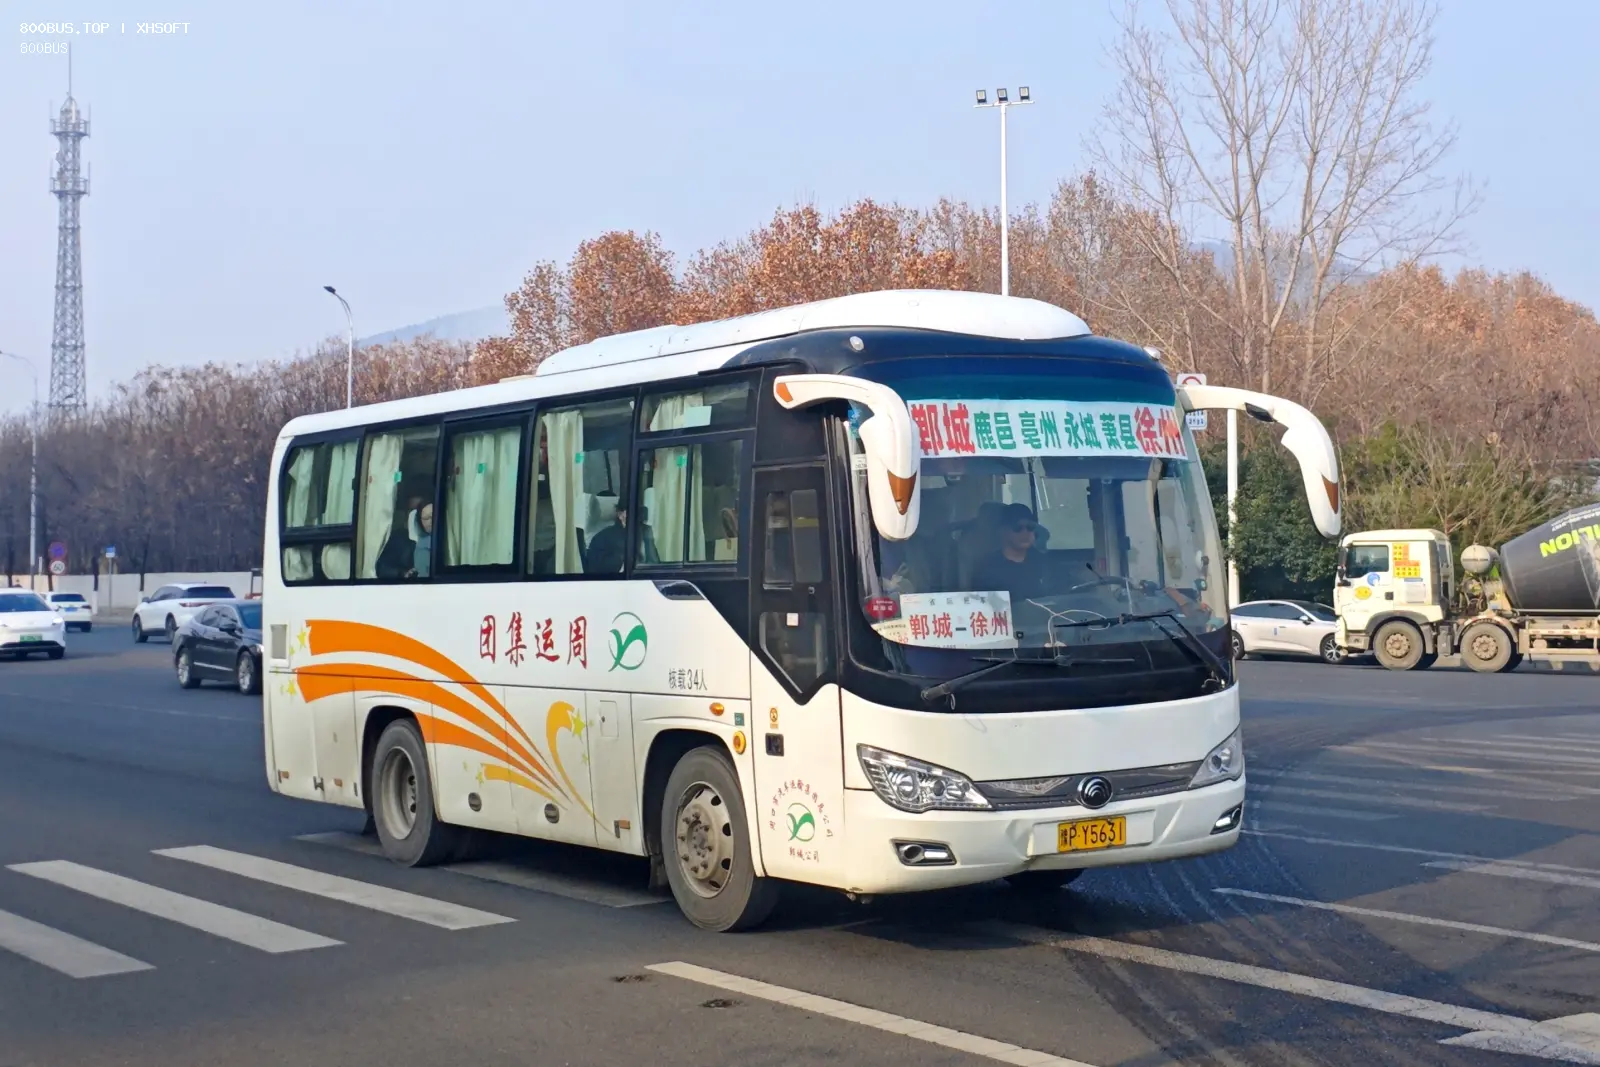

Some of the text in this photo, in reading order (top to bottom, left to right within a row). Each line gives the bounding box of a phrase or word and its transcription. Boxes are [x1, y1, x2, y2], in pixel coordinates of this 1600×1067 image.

[911, 403, 975, 455] 郸城
[973, 411, 1016, 450] 鹿邑
[1064, 411, 1102, 449] 永城
[1099, 412, 1139, 450] 萧县
[1134, 406, 1186, 456] 徐州
